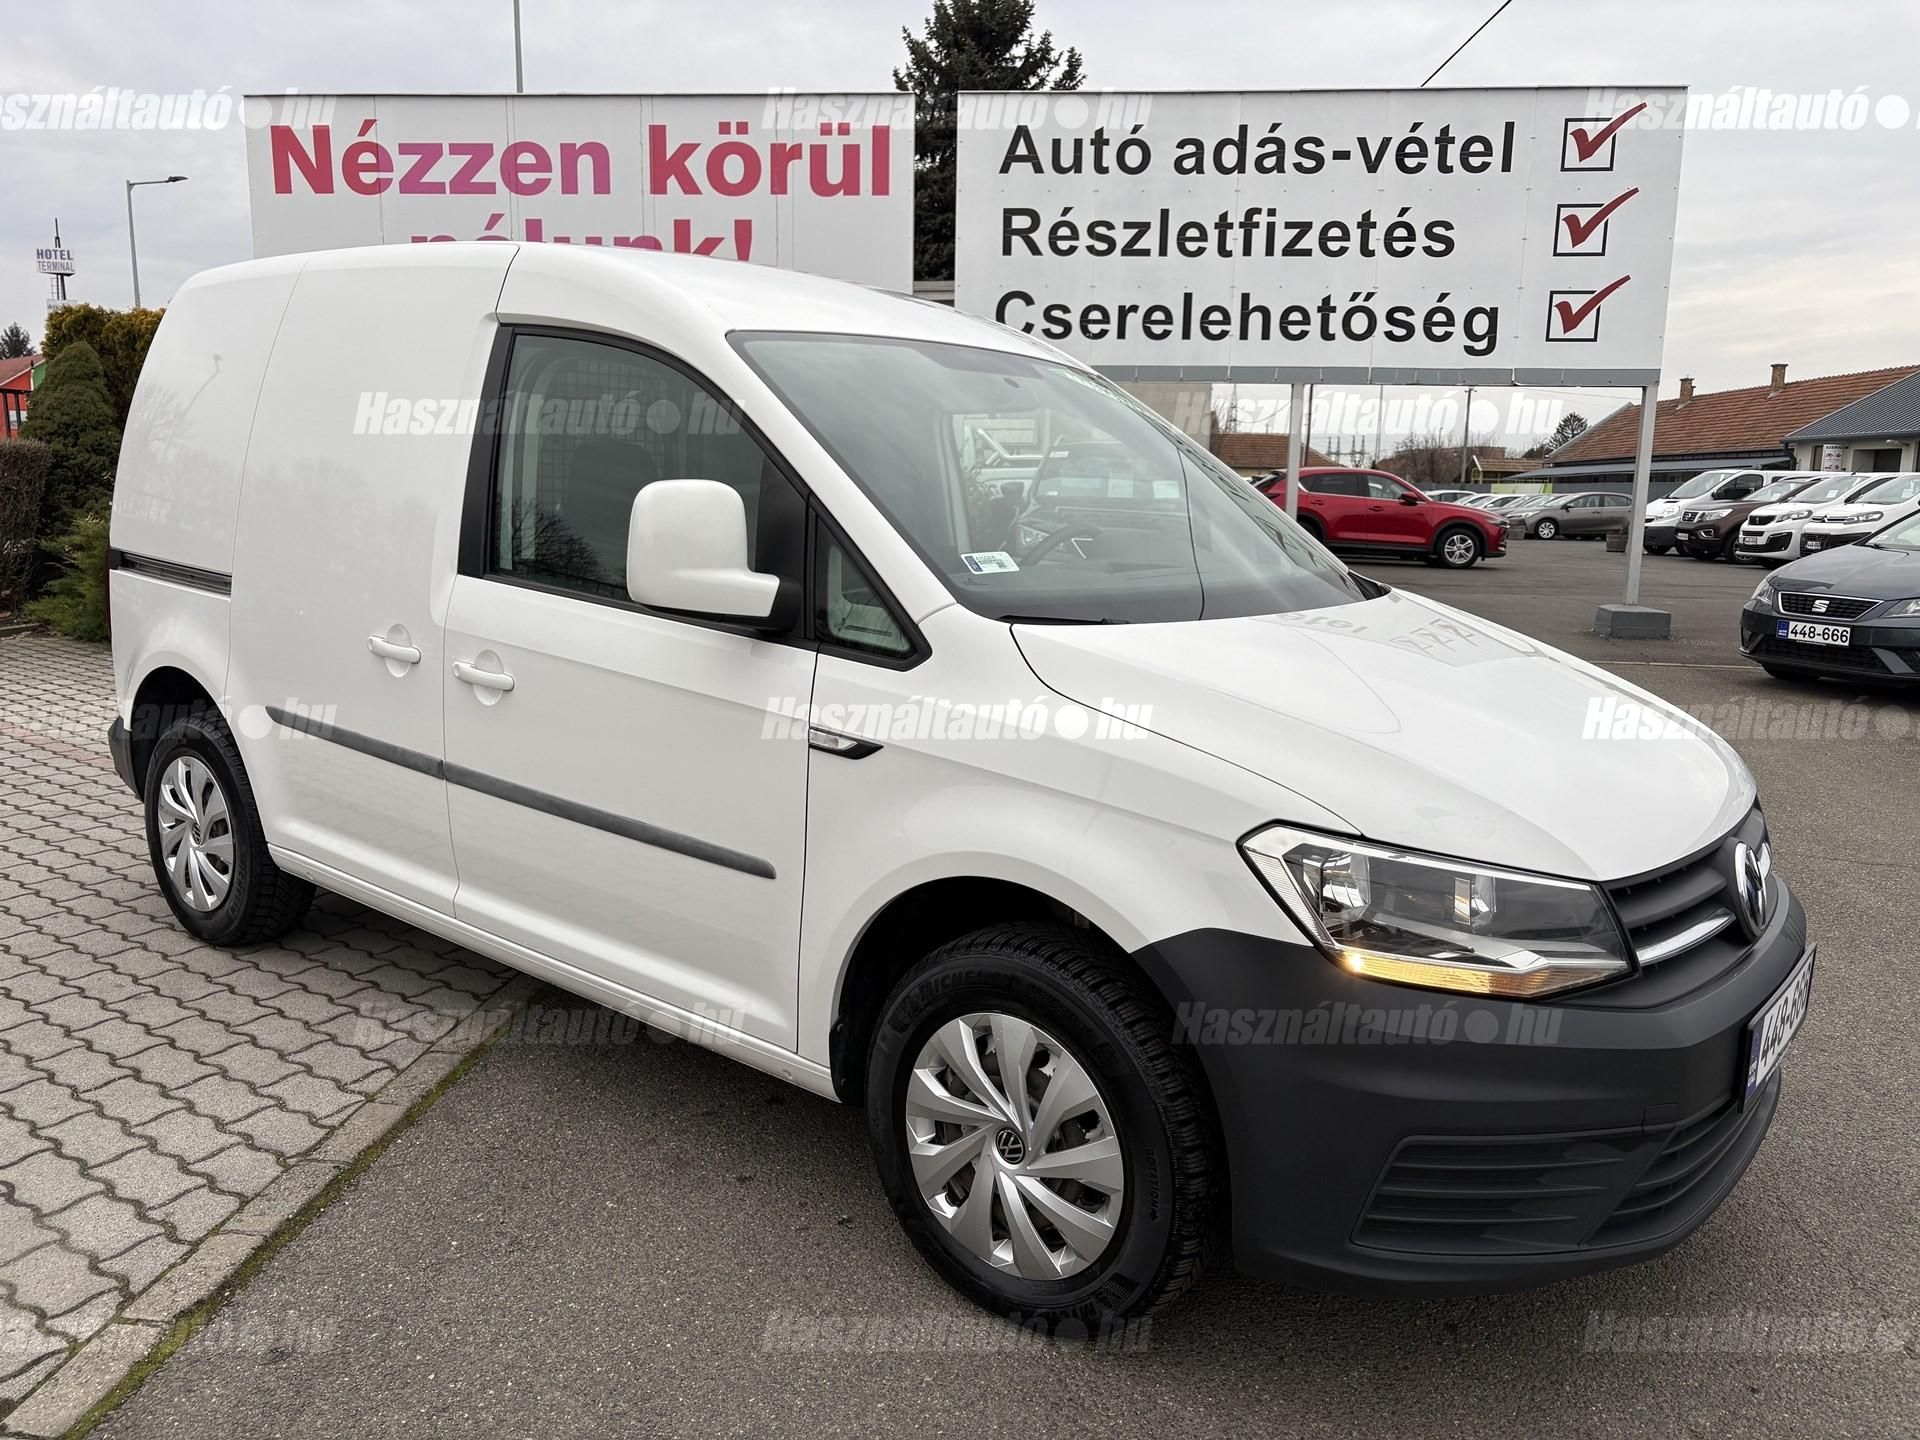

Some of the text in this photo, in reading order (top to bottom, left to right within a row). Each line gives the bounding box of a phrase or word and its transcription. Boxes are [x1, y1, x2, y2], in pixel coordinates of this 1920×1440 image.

[270, 119, 891, 197] Nézzen körül
[998, 121, 1516, 176] Autó adás-vétel
[36, 248, 74, 260] HOTEL
[1001, 206, 1456, 258] Részletfizetés
[37, 260, 76, 272] TERMINAL
[995, 290, 1499, 357] Cserelehetőség
[1790, 623, 1849, 644] 448-666
